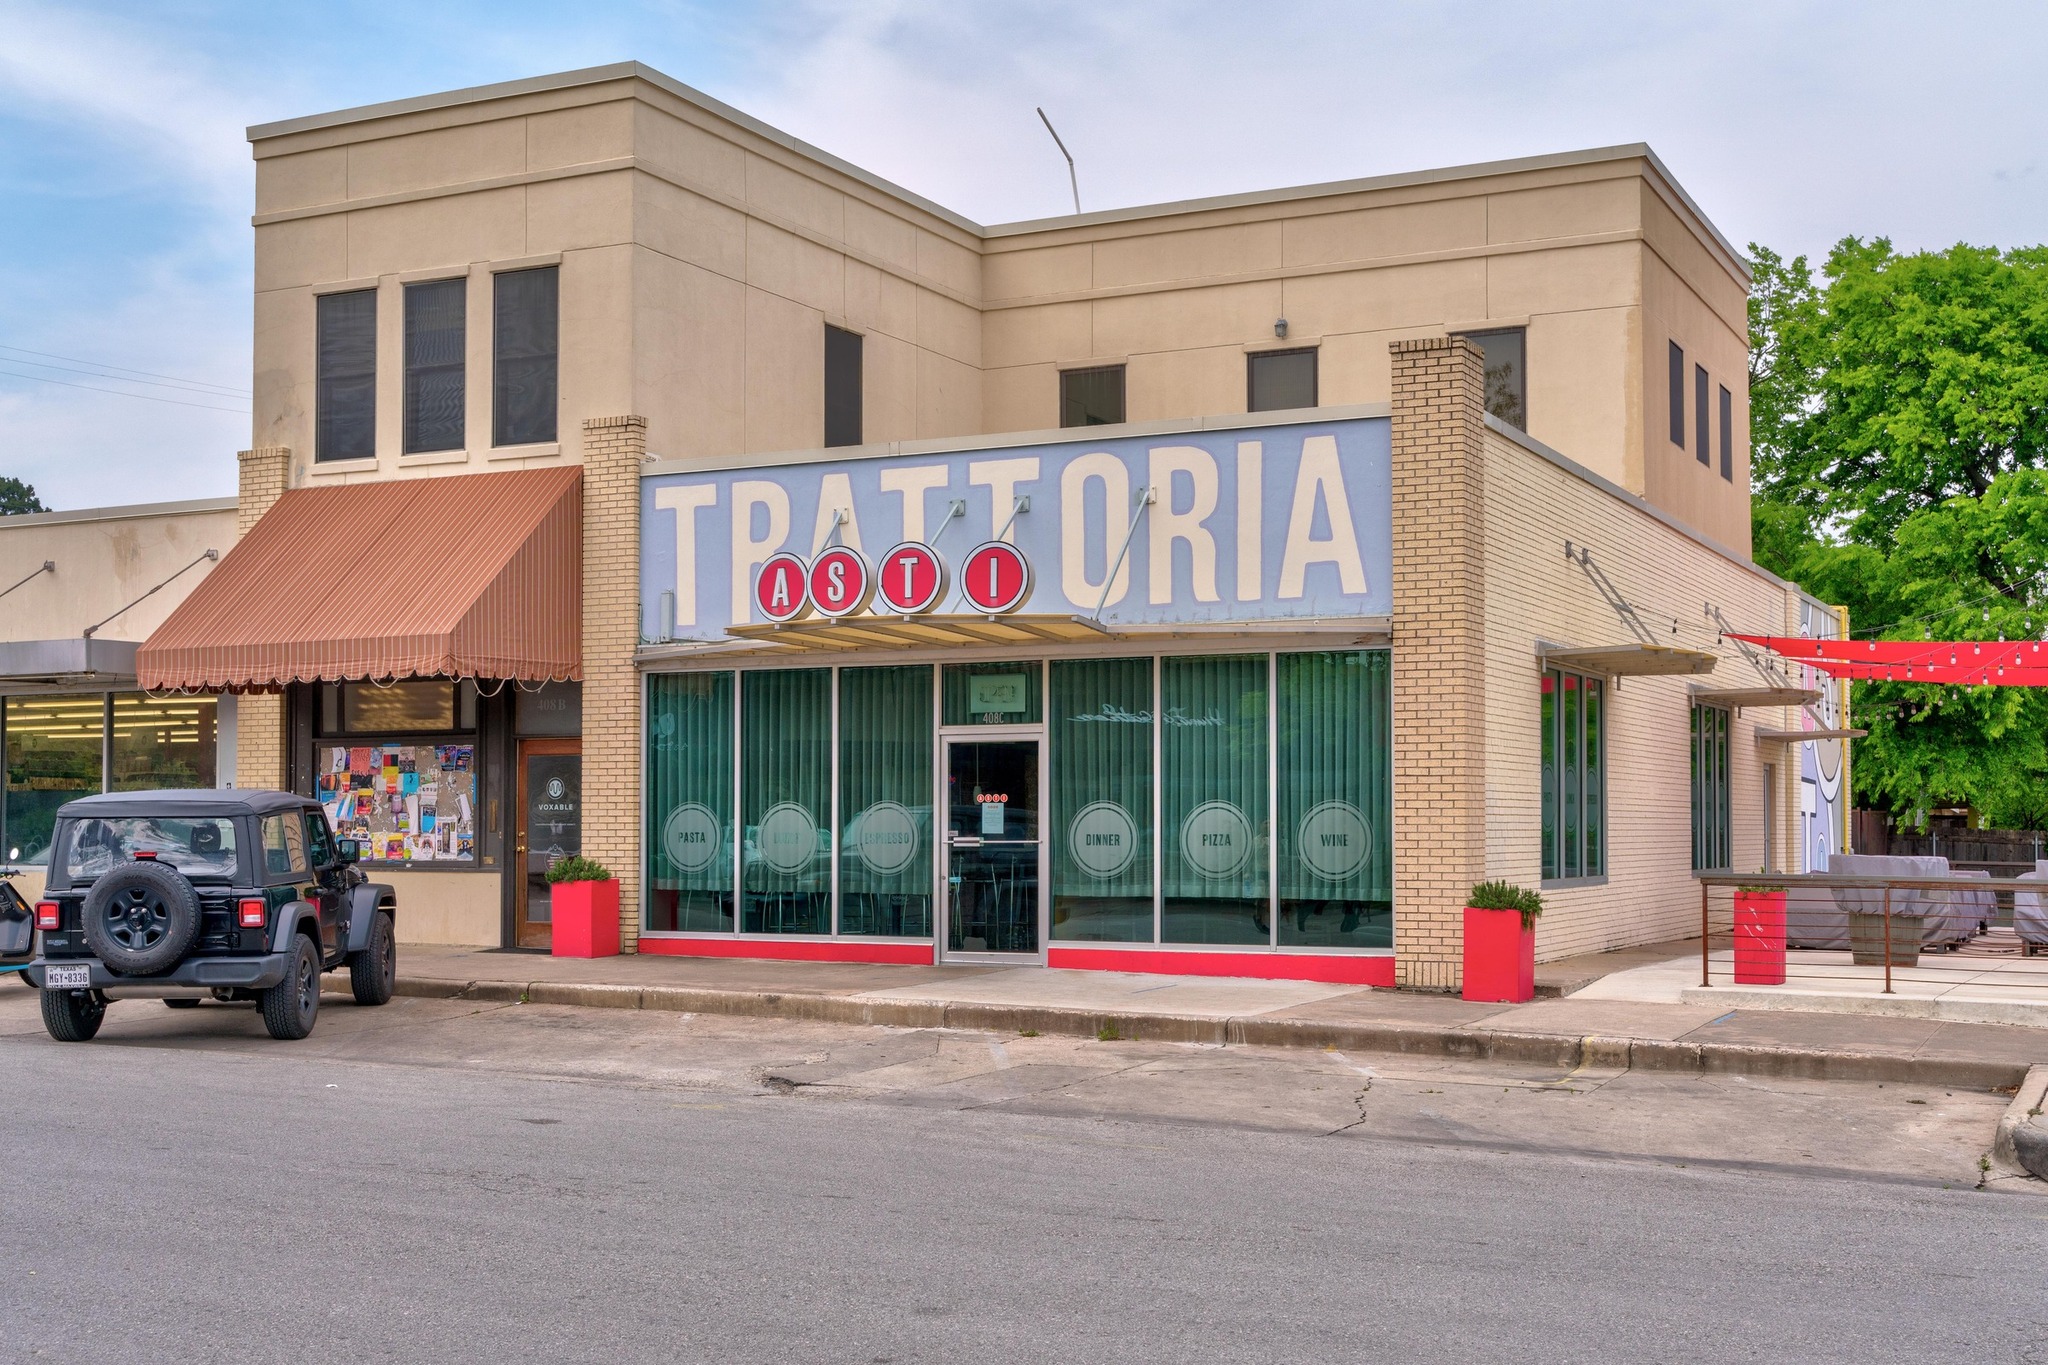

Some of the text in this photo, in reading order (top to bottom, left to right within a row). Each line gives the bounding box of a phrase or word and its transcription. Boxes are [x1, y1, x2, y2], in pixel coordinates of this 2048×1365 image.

[655, 435, 1368, 625] TRATTORIA
[771, 556, 999, 608] ASTI
[982, 712, 1004, 723] 408C
[538, 803, 573, 811] VOXABLE
[678, 831, 706, 844] PASTA
[864, 832, 910, 845] ESPRESSO
[1085, 833, 1121, 847] DINNER
[1202, 833, 1232, 847] PIZZA
[1320, 834, 1349, 847] WINE
